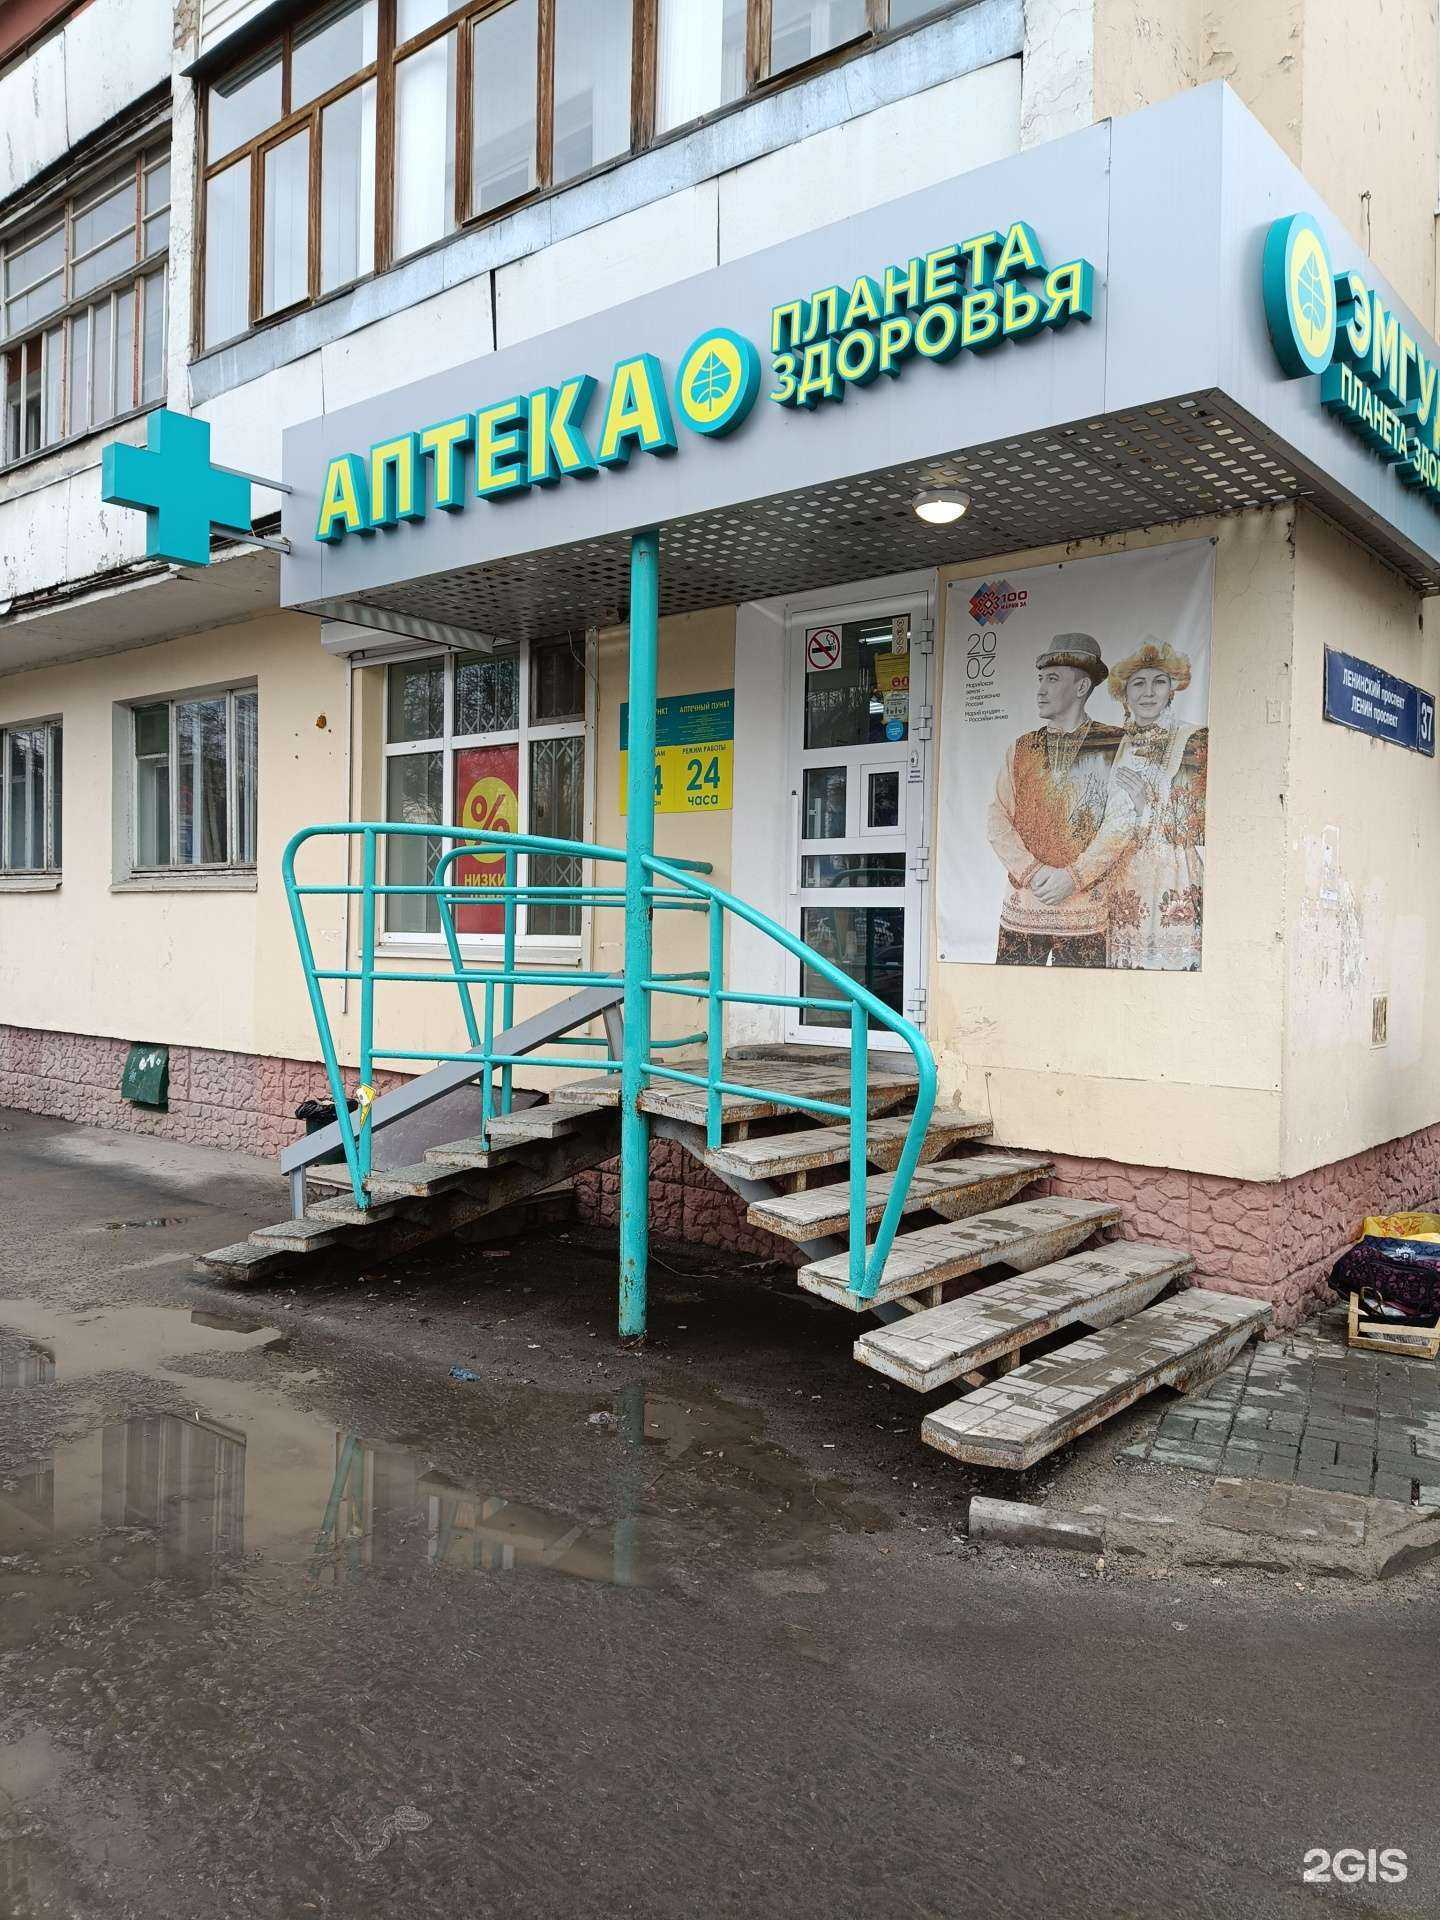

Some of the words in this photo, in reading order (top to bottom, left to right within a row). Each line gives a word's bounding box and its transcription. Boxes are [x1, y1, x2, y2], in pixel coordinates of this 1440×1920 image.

[770, 220, 1048, 356] ПЛАНЕТА
[769, 258, 1094, 411] ЗДОРОВЬЯ
[1338, 361, 1408, 460] ПЛАНЕТА
[315, 352, 678, 545] АПТЕКА
[1000, 590, 1028, 602] 100
[967, 631, 997, 655] 20
[1343, 668, 1380, 699] ЛЕНИНСКИЙ
[1381, 688, 1405, 710] проспект
[679, 702, 710, 714] АПТЕЧНЫЙ
[711, 700, 730, 711] ПУНКТ
[1351, 695, 1373, 718] ЛЕНИН
[1373, 707, 1398, 728] проспект
[1421, 702, 1433, 742] 37
[703, 743, 727, 752] РАБОТЫ
[686, 756, 720, 791] 24
[688, 794, 719, 806] часа
